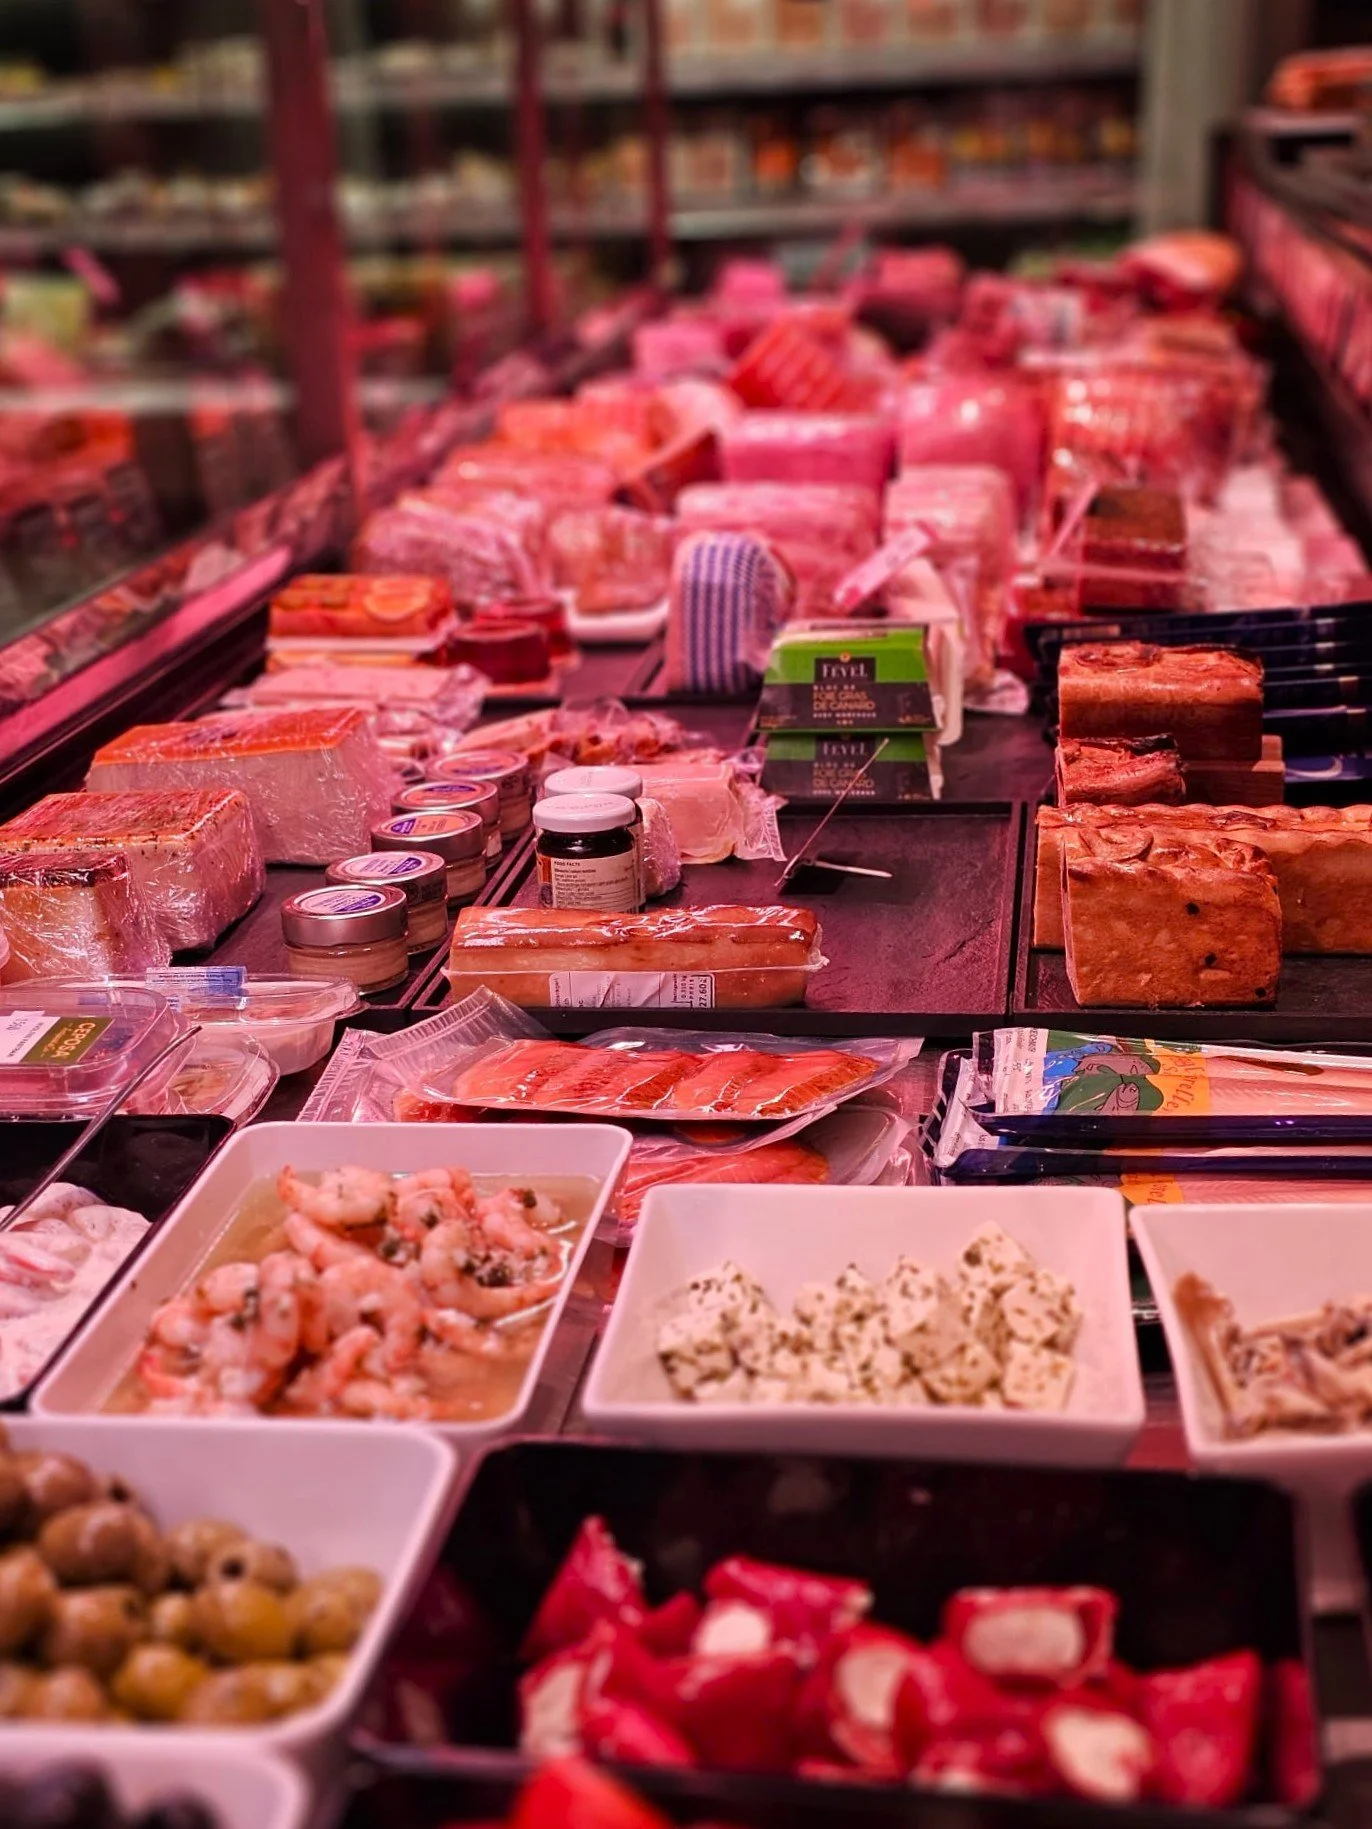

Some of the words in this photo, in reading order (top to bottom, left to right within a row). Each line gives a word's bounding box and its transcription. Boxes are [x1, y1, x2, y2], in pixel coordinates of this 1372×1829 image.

[813, 692, 835, 701] FOIE
[838, 691, 868, 701] GRAS
[813, 701, 828, 711] DE
[830, 701, 876, 711] CANARD
[698, 983, 707, 1008] 27.60
[51, 1022, 96, 1058] CEPOSA
